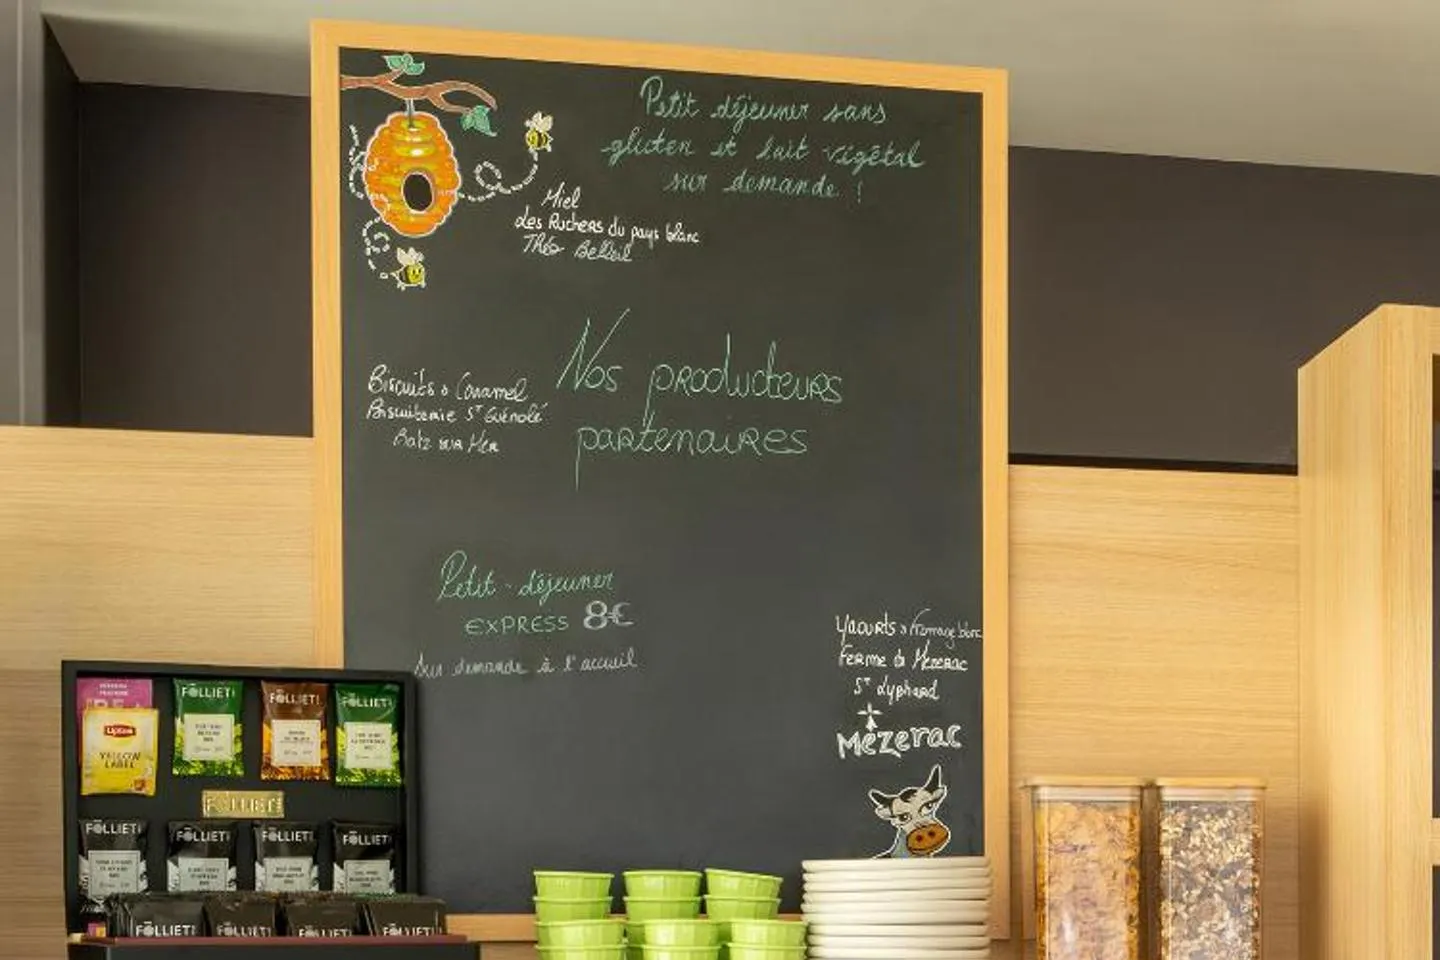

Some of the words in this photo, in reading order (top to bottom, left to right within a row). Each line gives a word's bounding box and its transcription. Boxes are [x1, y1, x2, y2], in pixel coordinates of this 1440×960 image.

[640, 76, 700, 118] Petit
[823, 101, 887, 124] sans
[601, 127, 695, 167] gluten
[711, 136, 738, 158] et
[756, 134, 810, 160] lait
[541, 181, 581, 210] Miel
[663, 171, 708, 193] sur
[723, 169, 837, 198] demande
[608, 216, 625, 238] du
[631, 226, 660, 250] pays
[666, 222, 700, 244] blanc
[368, 364, 435, 397] Biscuits
[456, 371, 528, 402] Caramel
[556, 307, 631, 392] Nos
[642, 332, 843, 427] producteurs
[574, 410, 809, 492] partenaires
[464, 615, 570, 636] EXPRESS
[583, 599, 635, 630] 8€
[835, 611, 897, 646] Yaourts
[451, 657, 528, 676] demande
[838, 644, 887, 667] Ferme
